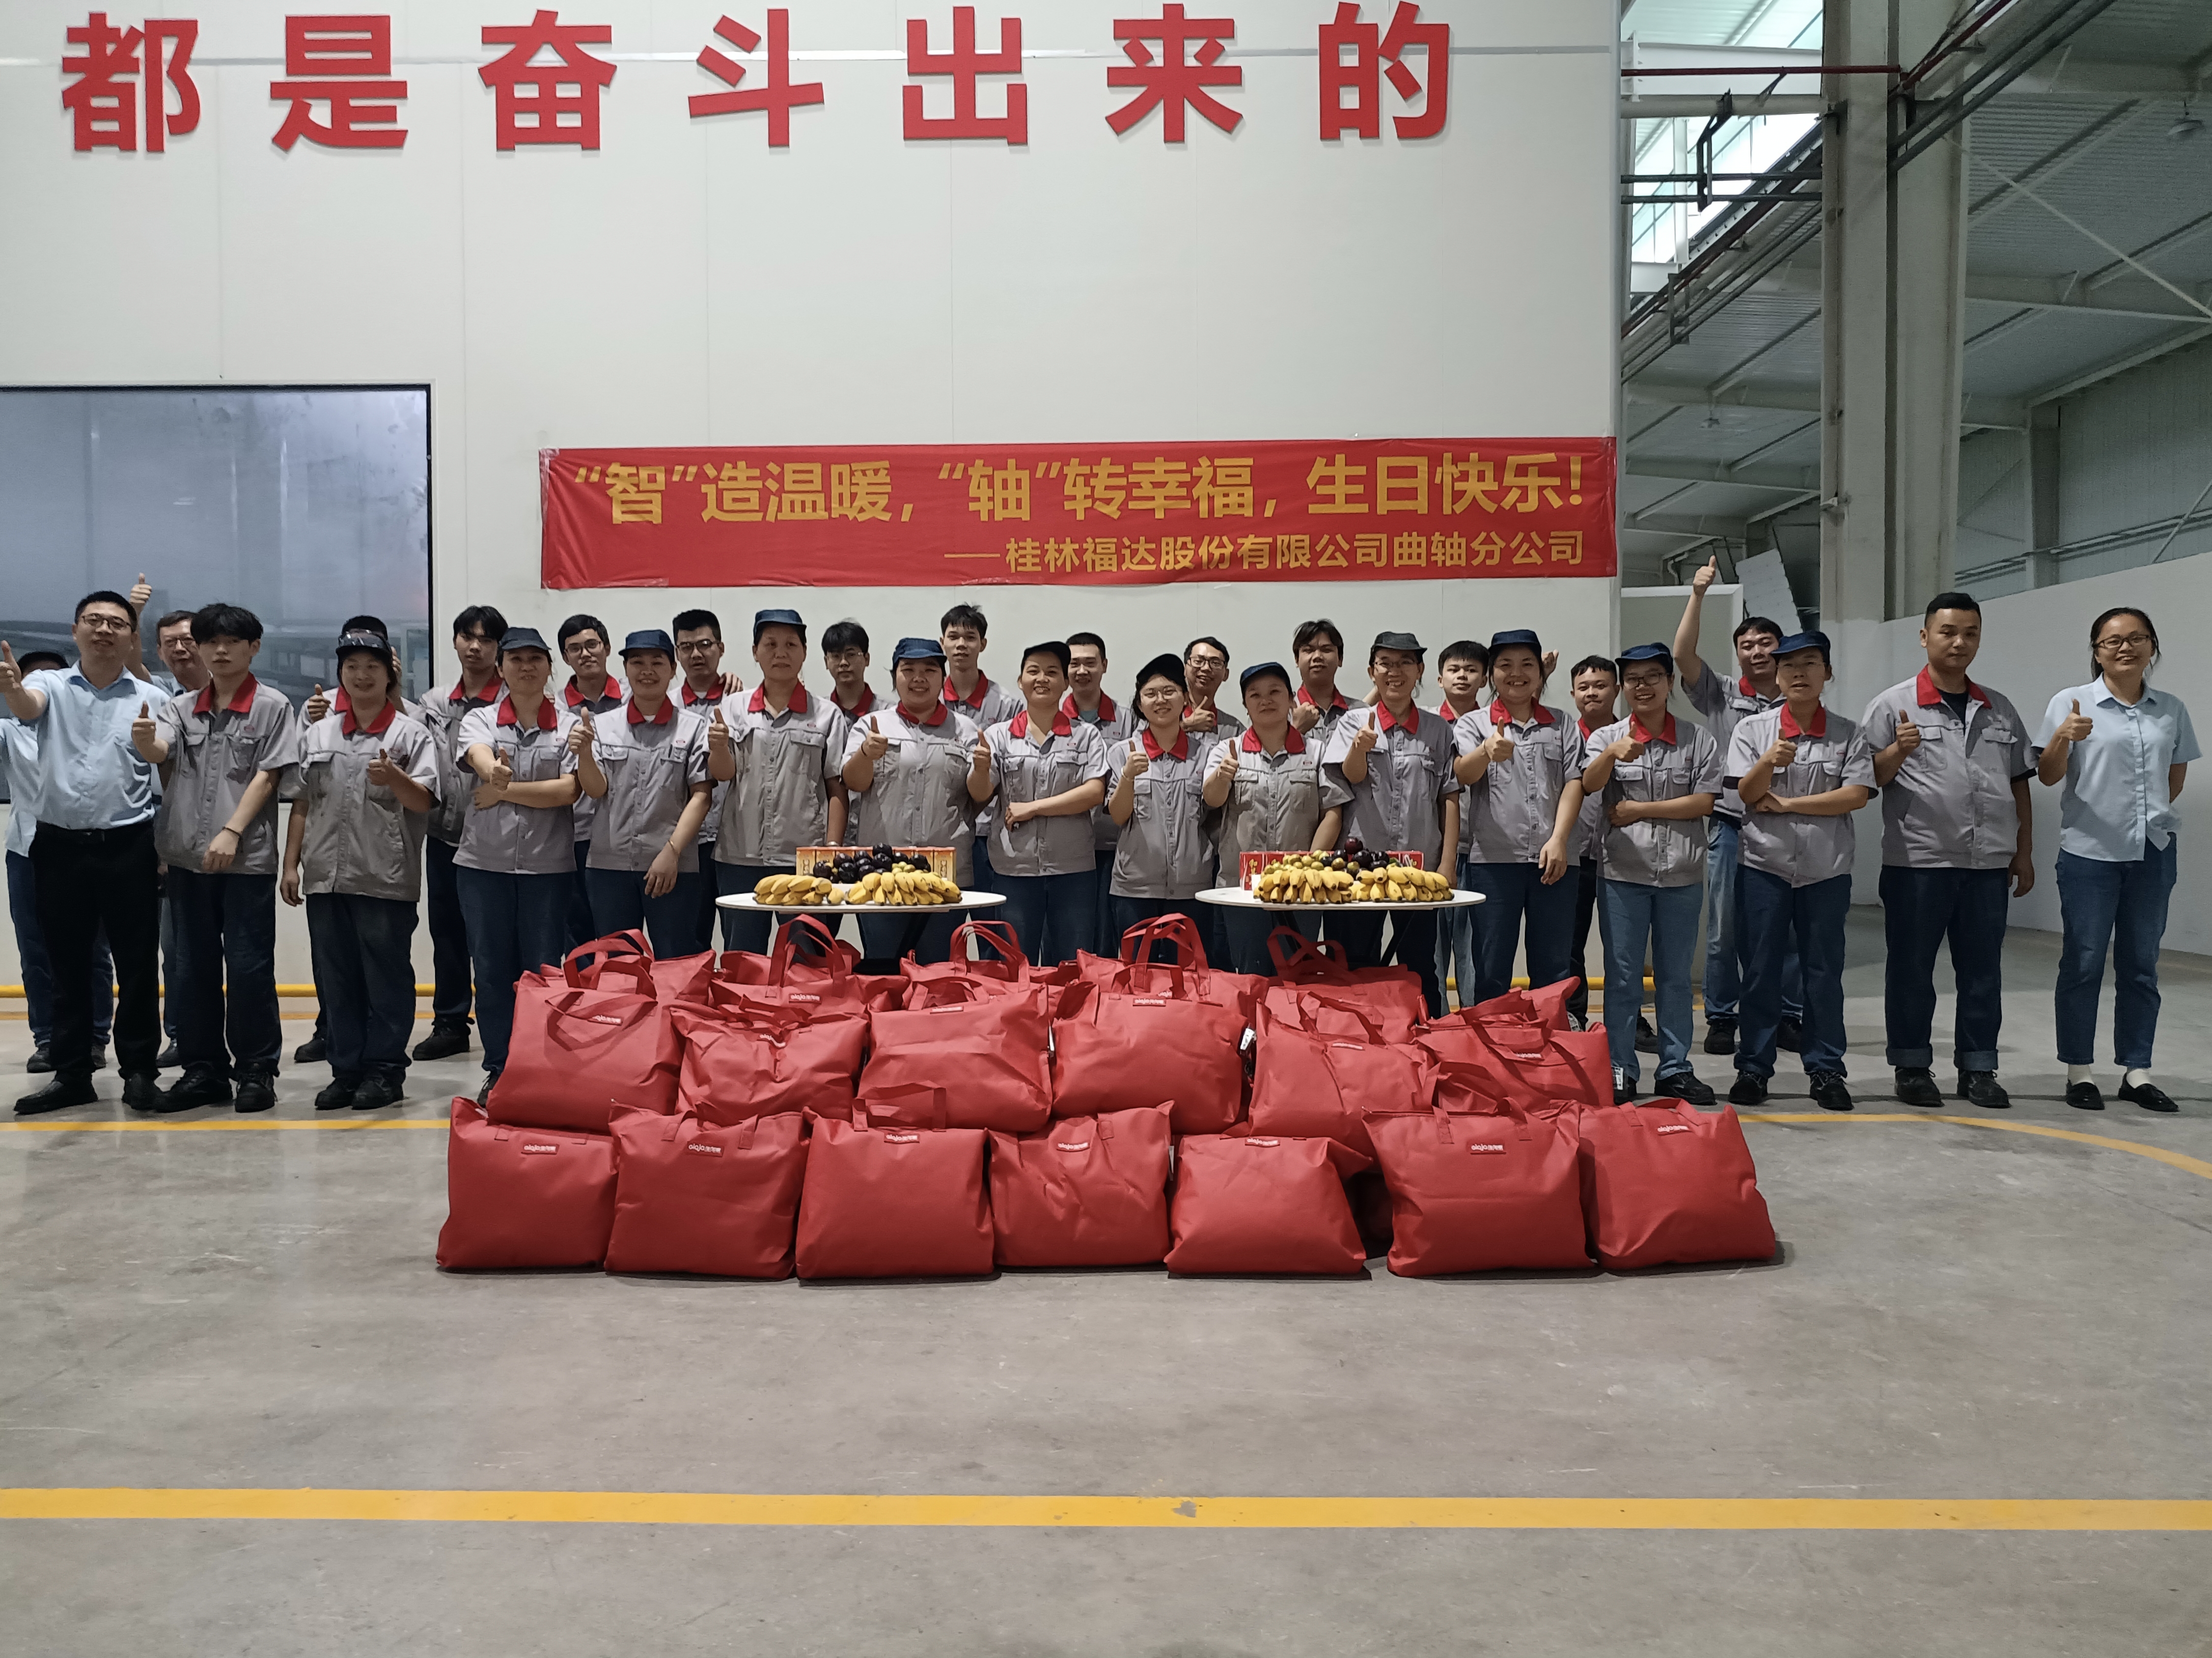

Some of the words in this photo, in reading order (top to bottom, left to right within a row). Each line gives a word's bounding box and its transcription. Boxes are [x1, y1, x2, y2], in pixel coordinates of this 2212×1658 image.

[63, 1, 1449, 151] 都是奋斗出来的
